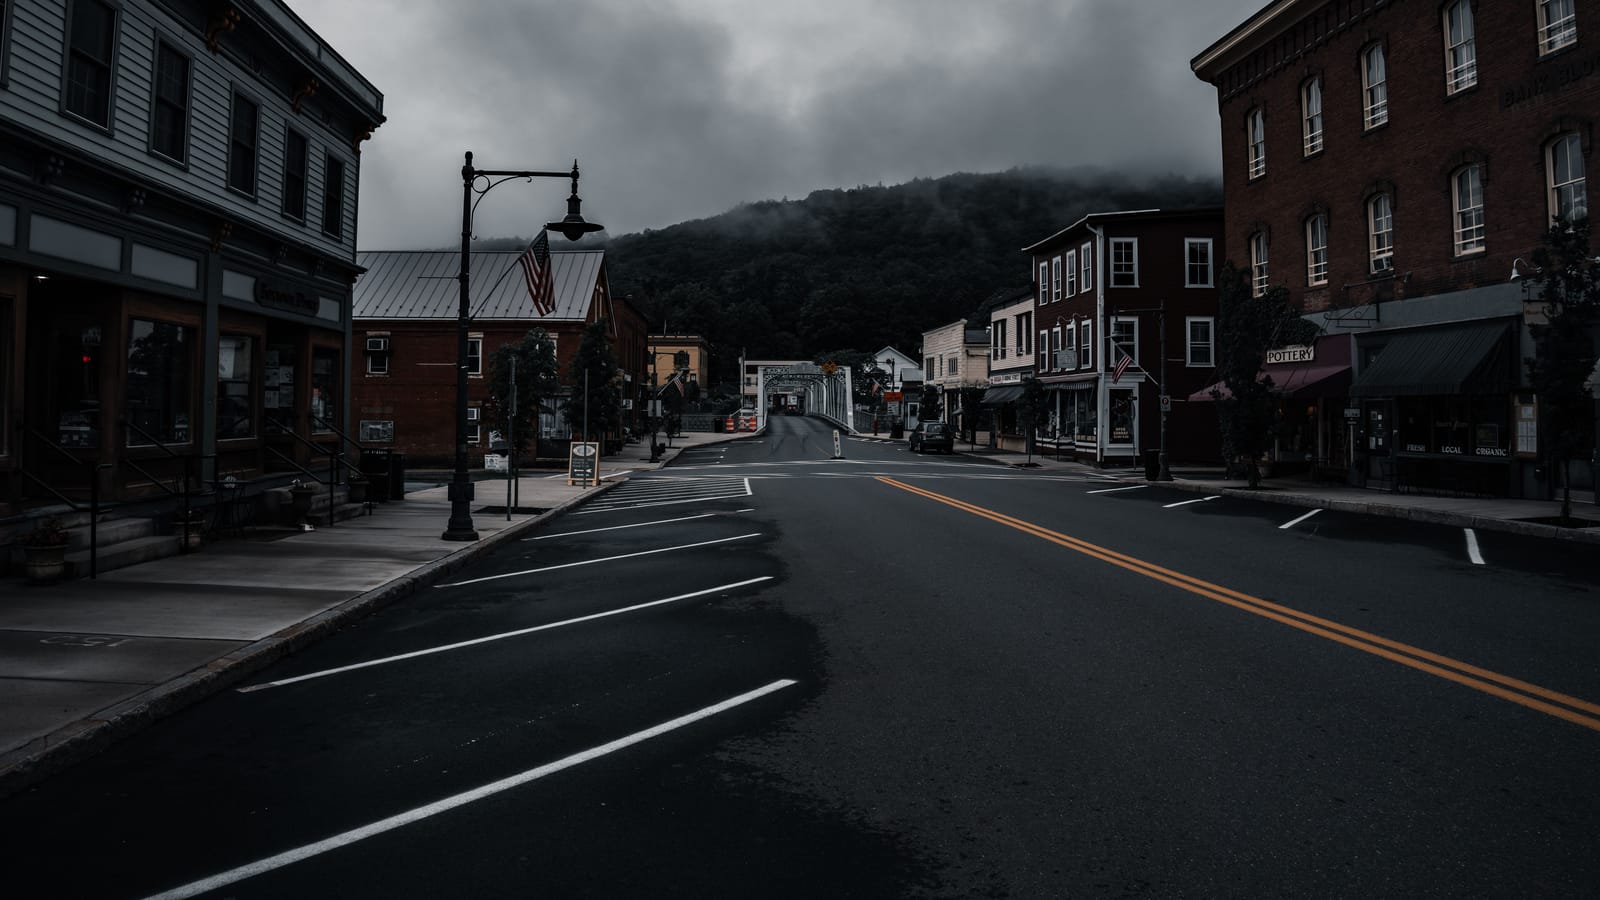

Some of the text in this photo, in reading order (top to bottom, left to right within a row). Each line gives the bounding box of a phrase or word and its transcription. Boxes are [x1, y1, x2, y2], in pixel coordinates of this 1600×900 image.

[1504, 73, 1550, 108] BANK
[1268, 348, 1313, 362] POTTERY
[1441, 445, 1463, 454] LOCAL
[1475, 447, 1508, 457] ORGANIC
